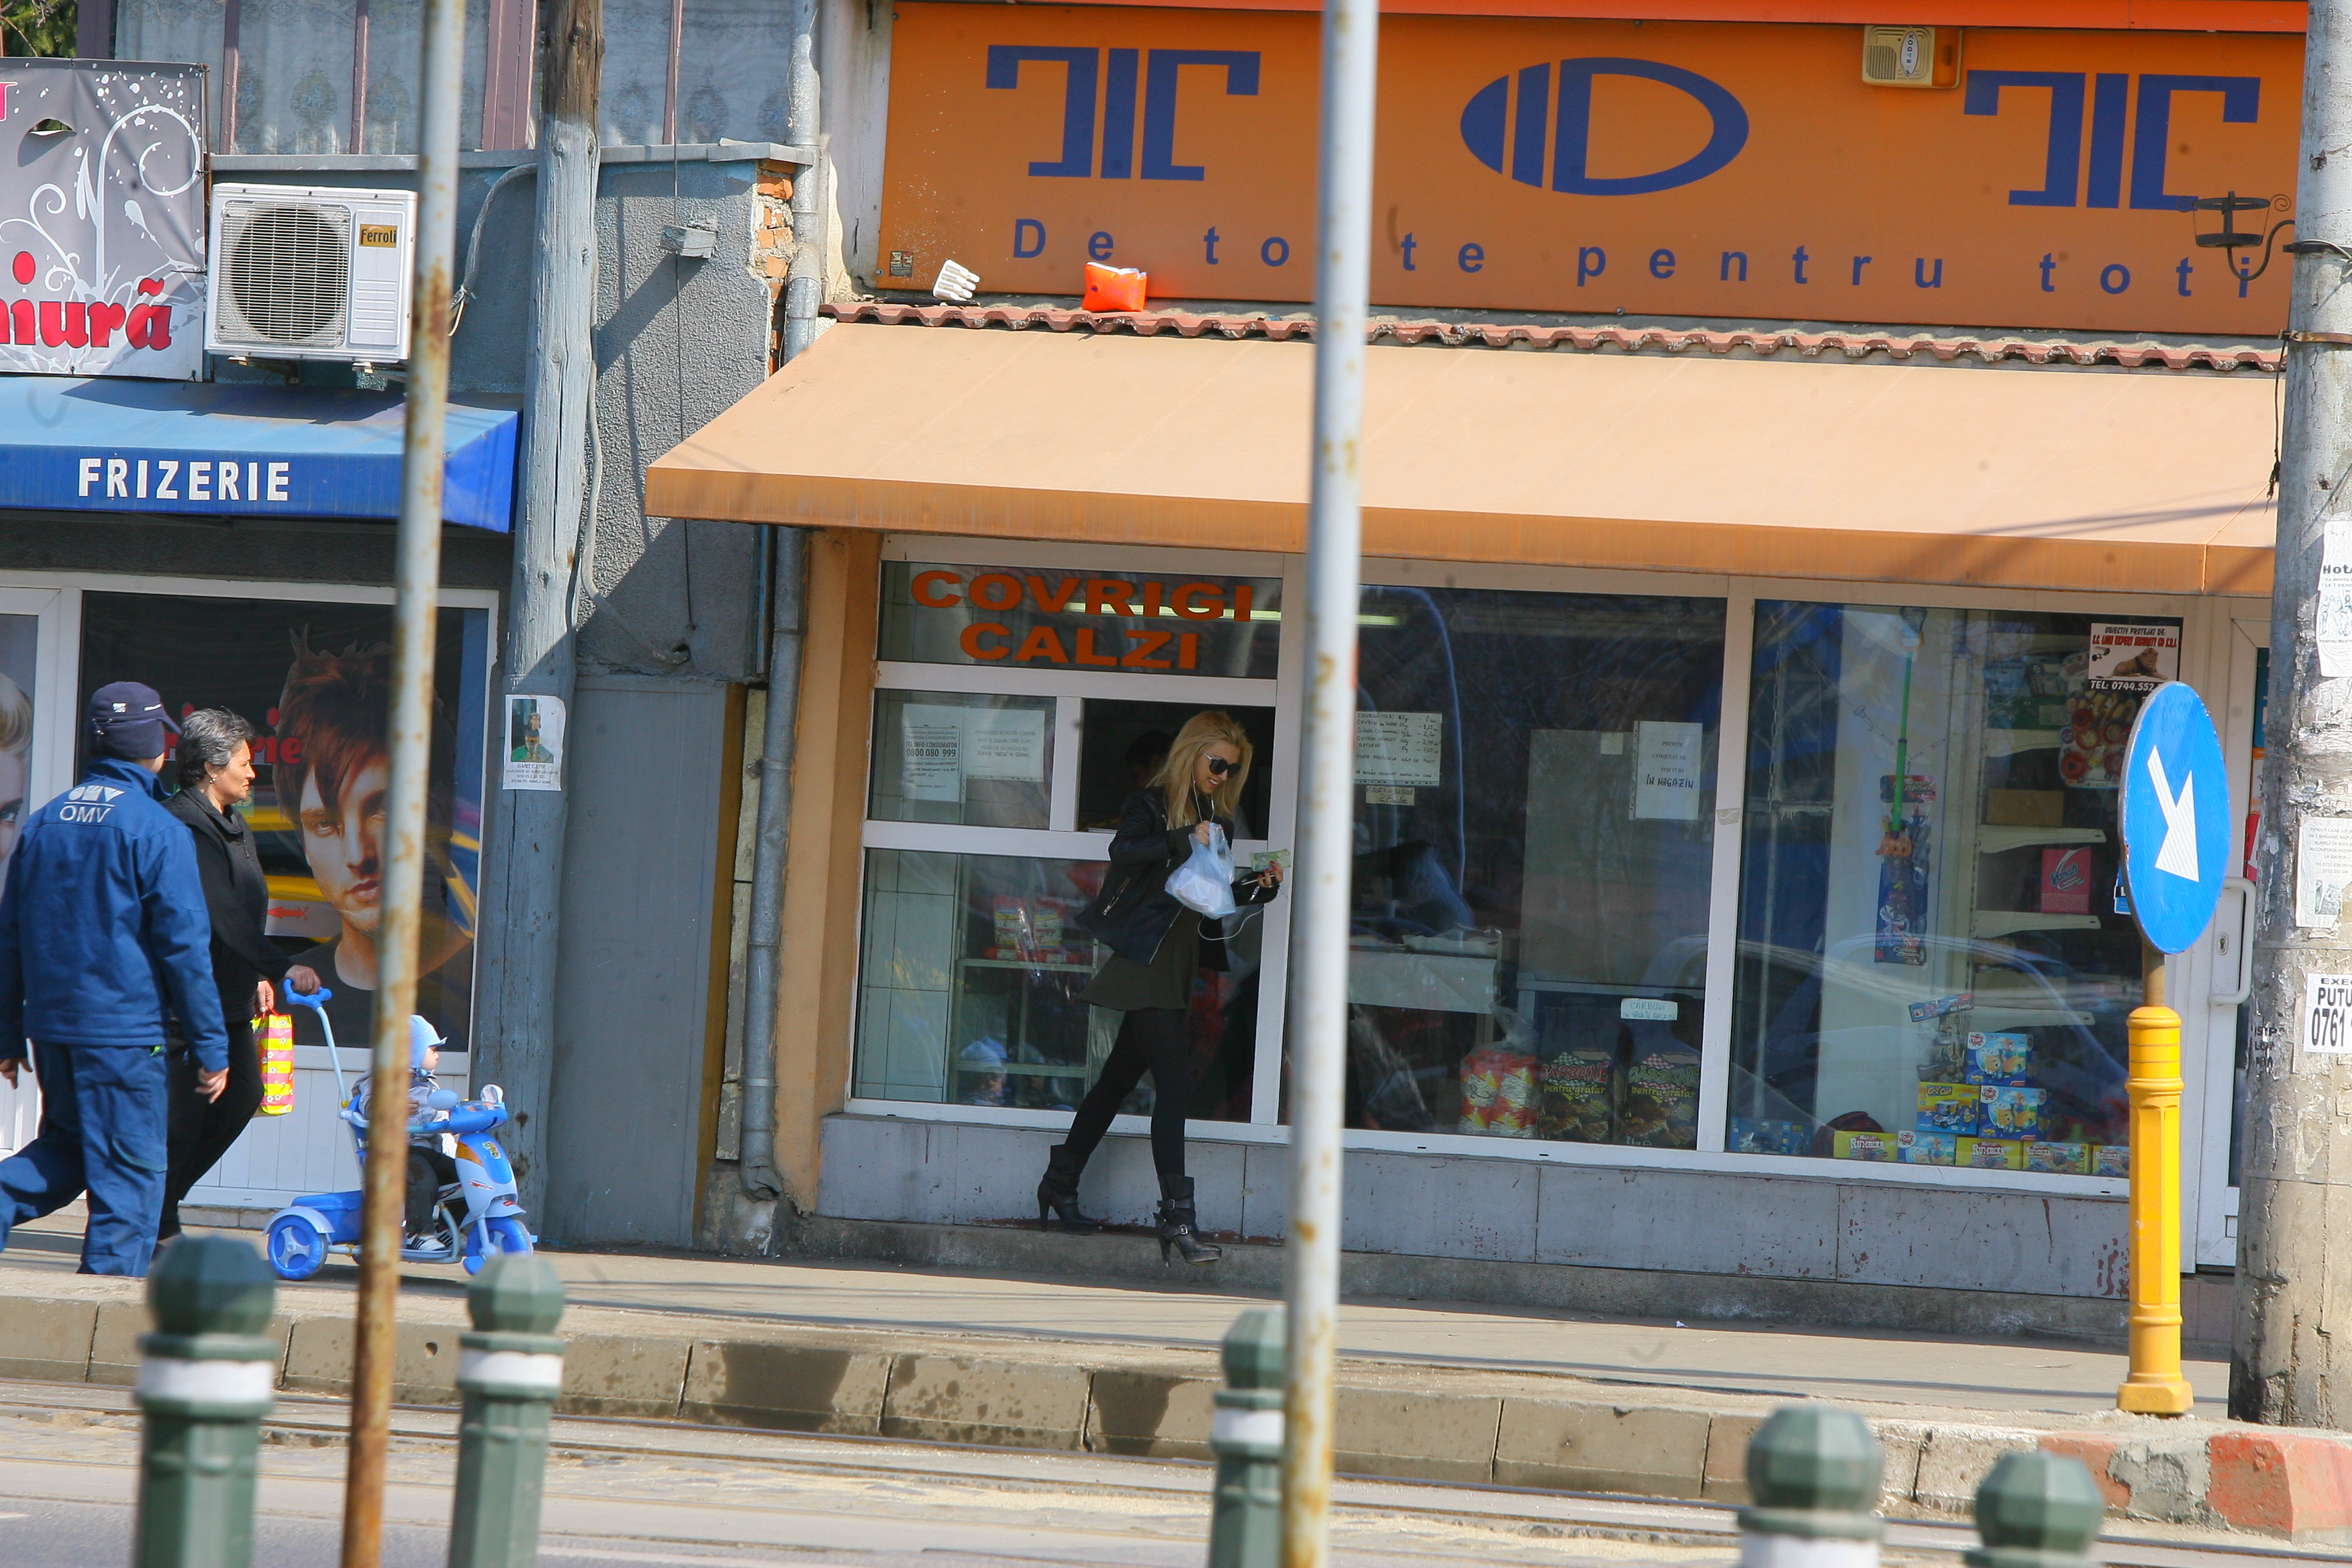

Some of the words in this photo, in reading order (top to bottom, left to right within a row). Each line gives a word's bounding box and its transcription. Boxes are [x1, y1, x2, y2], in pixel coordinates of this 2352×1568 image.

[1906, 33, 1914, 64] RADOX
[360, 228, 397, 245] Ferroli
[1013, 219, 1114, 260] De
[1203, 226, 1485, 274] tote
[1577, 244, 1943, 289] pentru
[2039, 252, 2250, 299] toti
[77, 458, 290, 502] FRIZERIE
[911, 570, 1253, 622] COVRIGI
[2105, 626, 2128, 634] OBIECTIV
[2130, 628, 2155, 636] PROTEJAT
[960, 622, 1198, 670] CALZI
[2090, 681, 2109, 689] TEL:
[906, 748, 924, 757] 0800
[925, 748, 939, 757] 080
[942, 749, 956, 757] 999
[59, 805, 111, 823] OMV
[2049, 861, 2078, 887] Vanish
[2312, 1008, 2345, 1046] 0761
[1544, 1083, 1572, 1093] pentru
[1632, 1085, 1662, 1096] pentru
[1849, 1137, 1885, 1150] RUMBLER
[1972, 1144, 2006, 1157] RUMBLER
